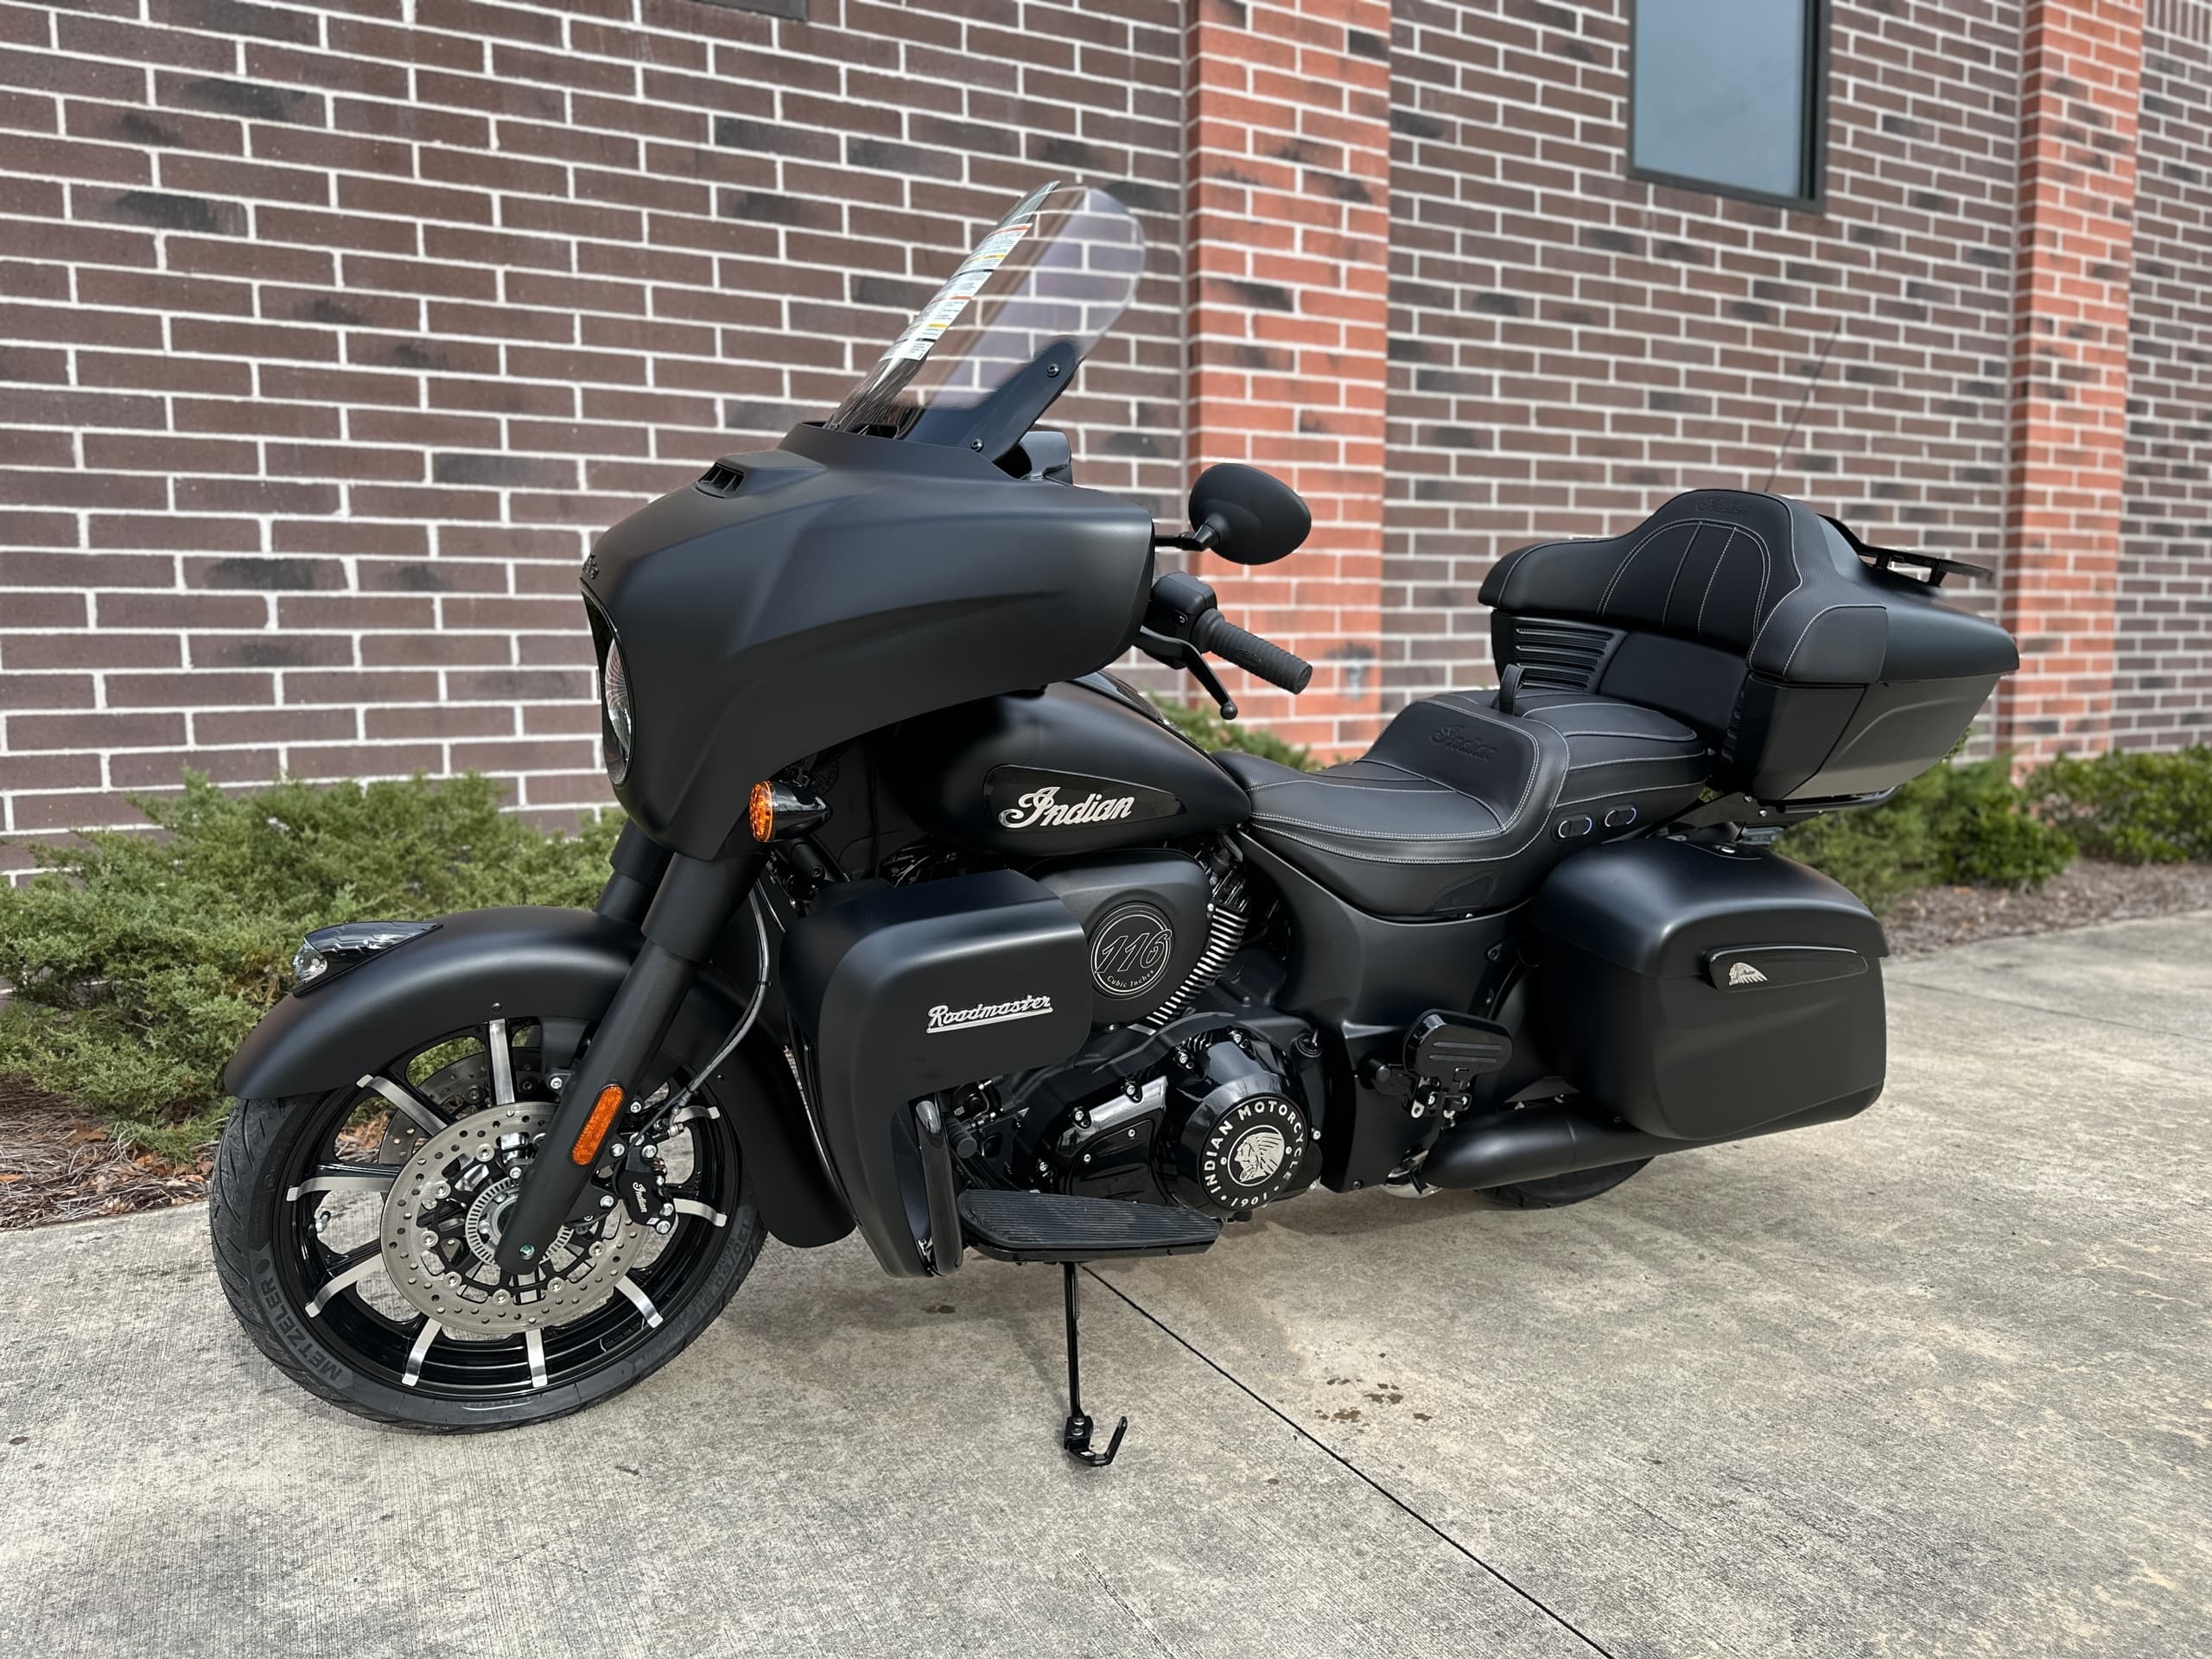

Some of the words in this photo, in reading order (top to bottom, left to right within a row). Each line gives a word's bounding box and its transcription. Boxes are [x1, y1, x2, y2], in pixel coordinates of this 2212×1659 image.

[998, 786, 1135, 829] Indian
[1093, 929, 1173, 974] 116
[1107, 975, 1128, 988] Cubic
[1129, 969, 1155, 988] Inches
[927, 995, 1052, 1030] Roadmaster
[1204, 1120, 1234, 1194] INDIAN
[1237, 1100, 1304, 1181] MOTORCYCLE
[632, 1181, 648, 1213] Indian
[1230, 1192, 1268, 1207] 1901
[259, 1276, 343, 1381] METZELER
